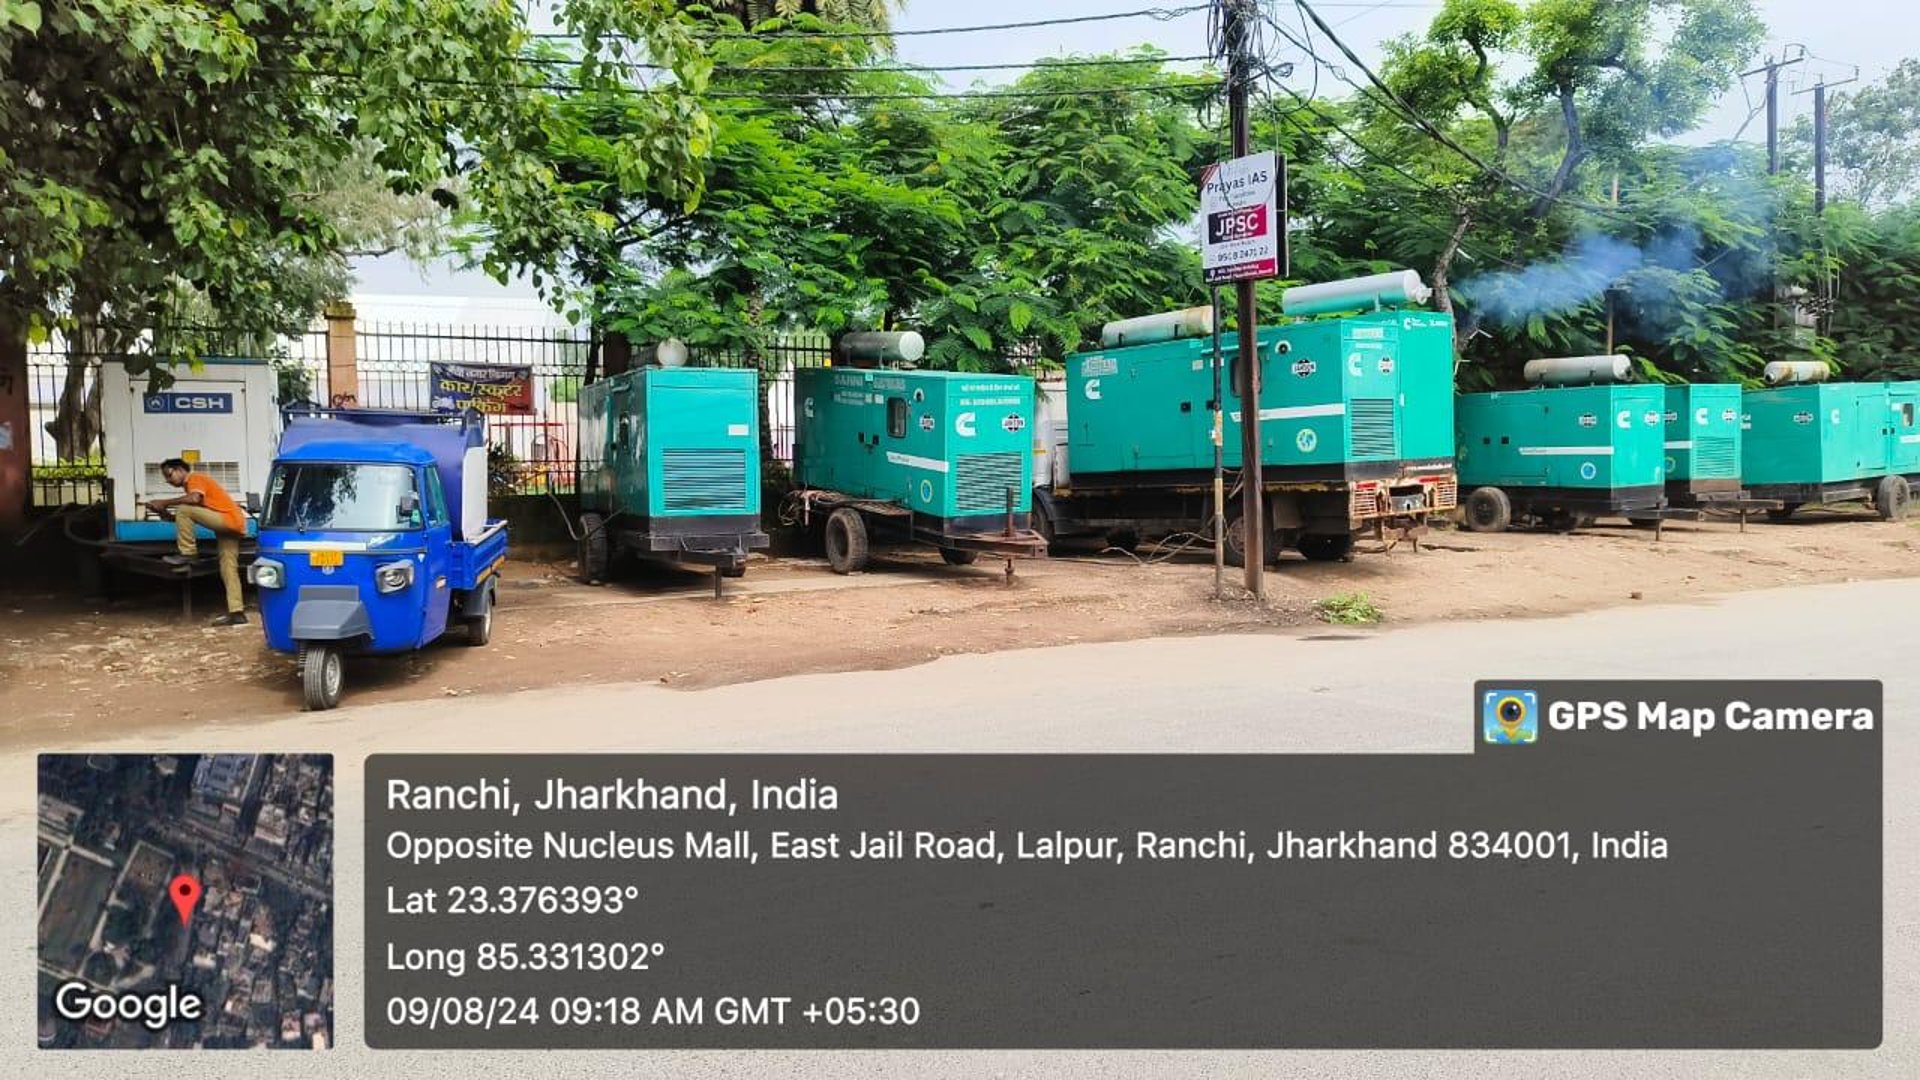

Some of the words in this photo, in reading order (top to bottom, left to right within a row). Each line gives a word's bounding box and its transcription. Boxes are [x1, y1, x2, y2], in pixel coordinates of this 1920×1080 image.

[1207, 177, 1244, 194] Prayas
[1248, 170, 1268, 185] IAS
[1216, 213, 1258, 237] JPSC
[175, 396, 225, 409] CSH
